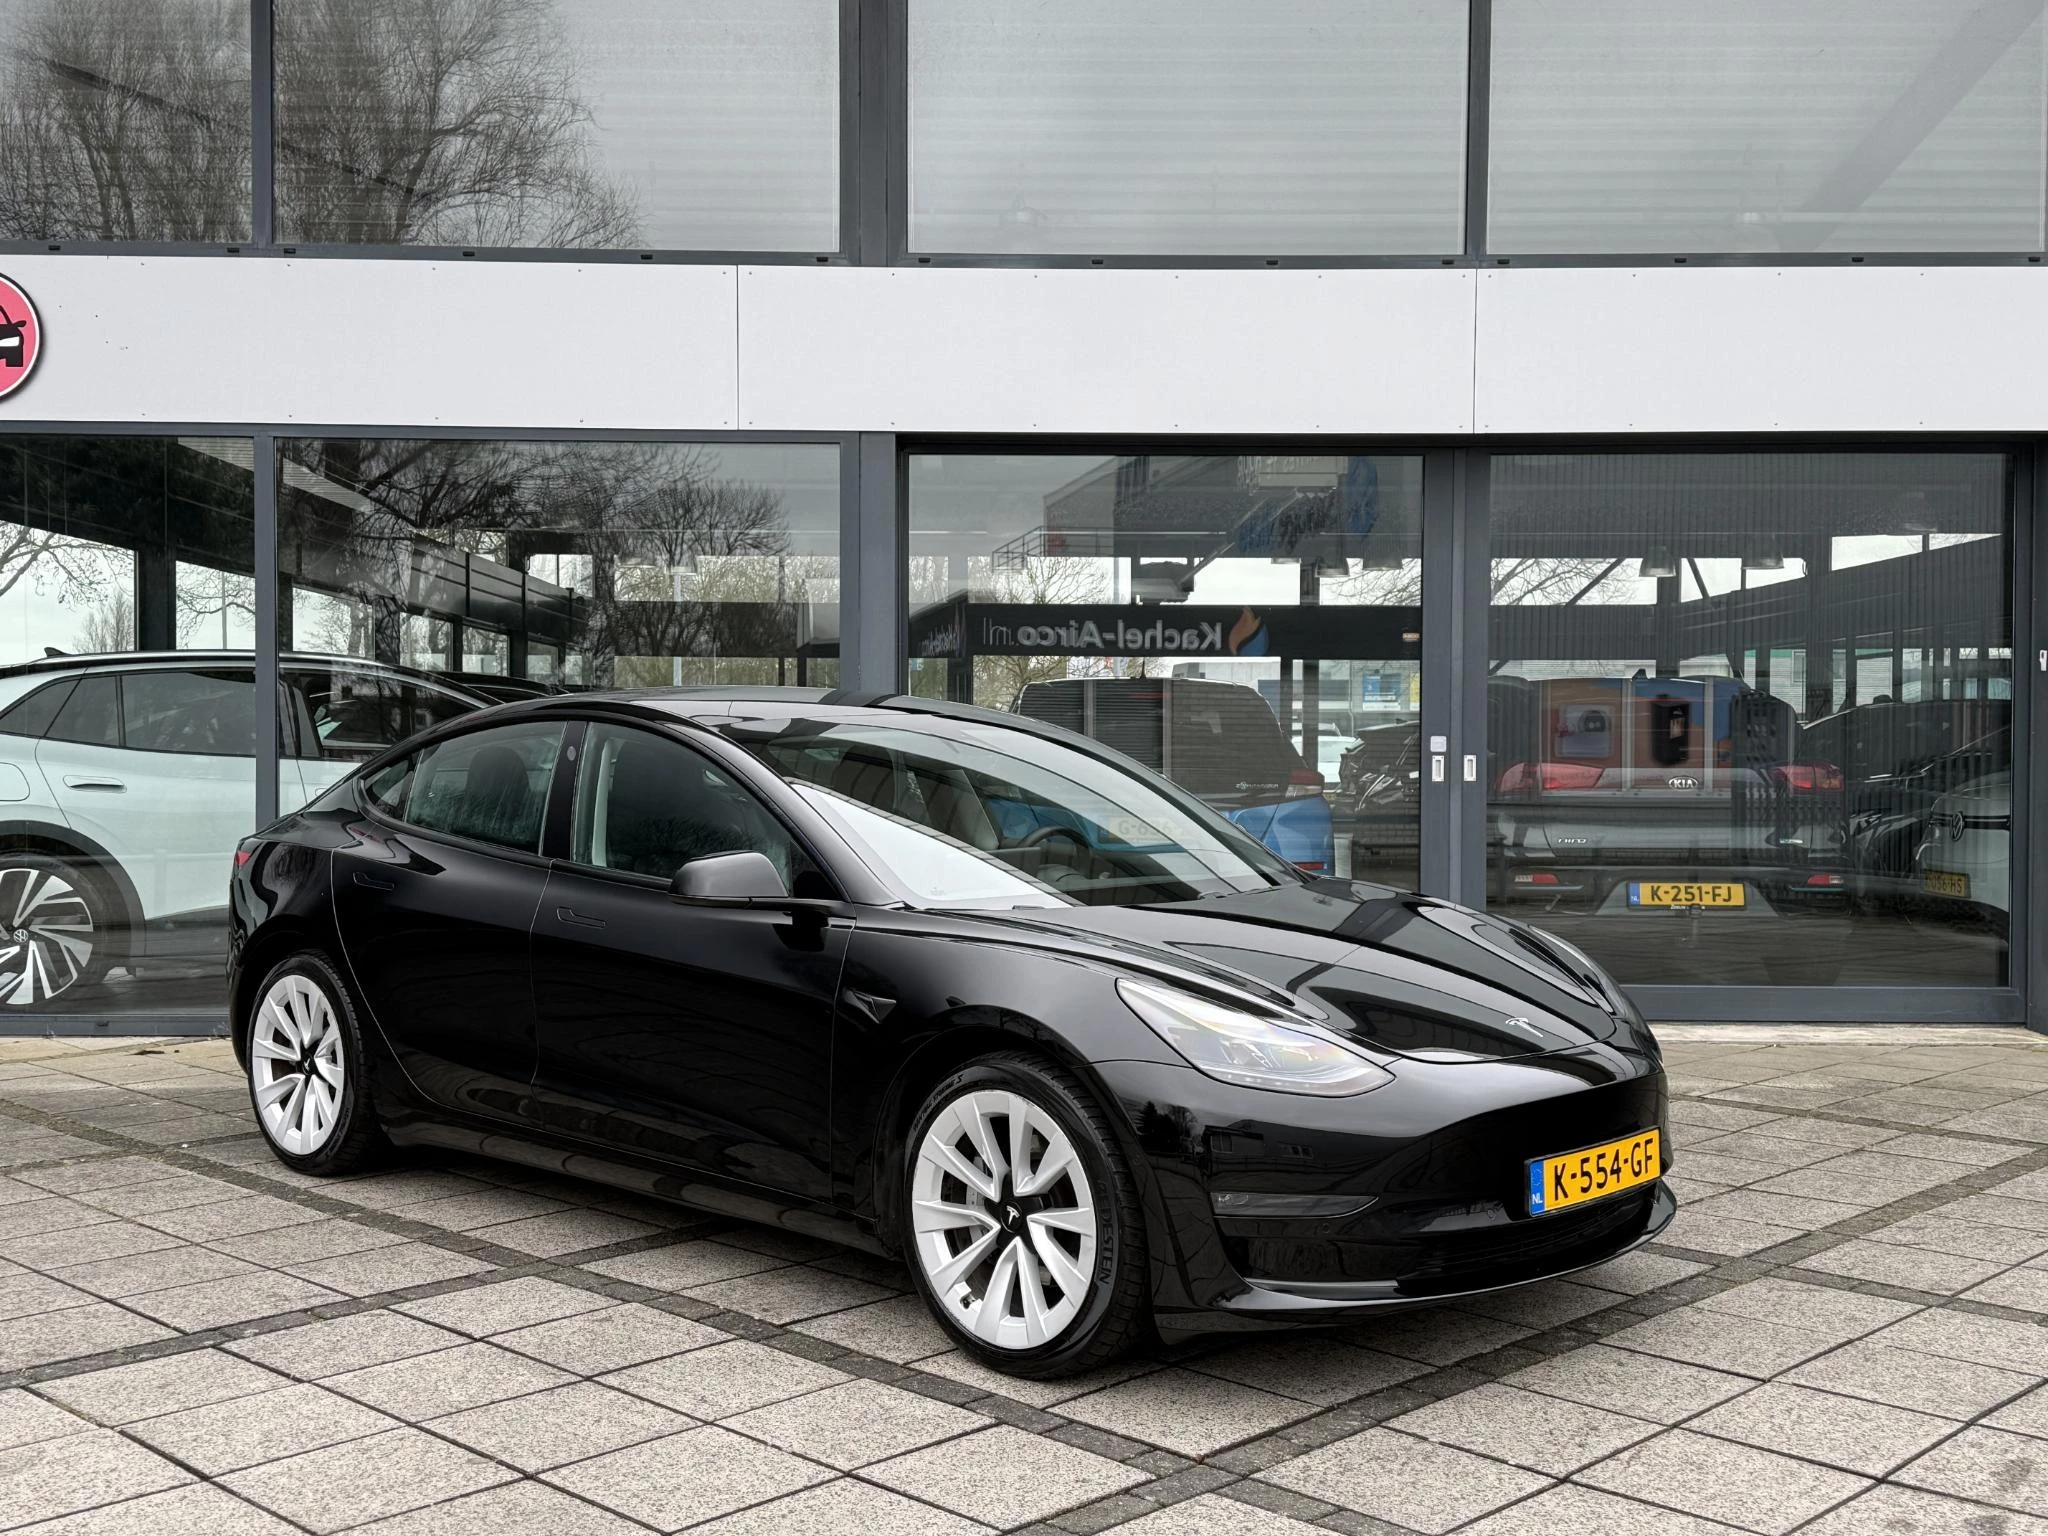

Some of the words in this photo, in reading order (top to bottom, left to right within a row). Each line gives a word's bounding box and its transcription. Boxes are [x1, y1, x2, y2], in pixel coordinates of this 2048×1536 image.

[1650, 884, 1732, 903] K-251-FJ
[1553, 1137, 1654, 1202] K-554-GF
[1531, 1192, 1543, 1205] NL
